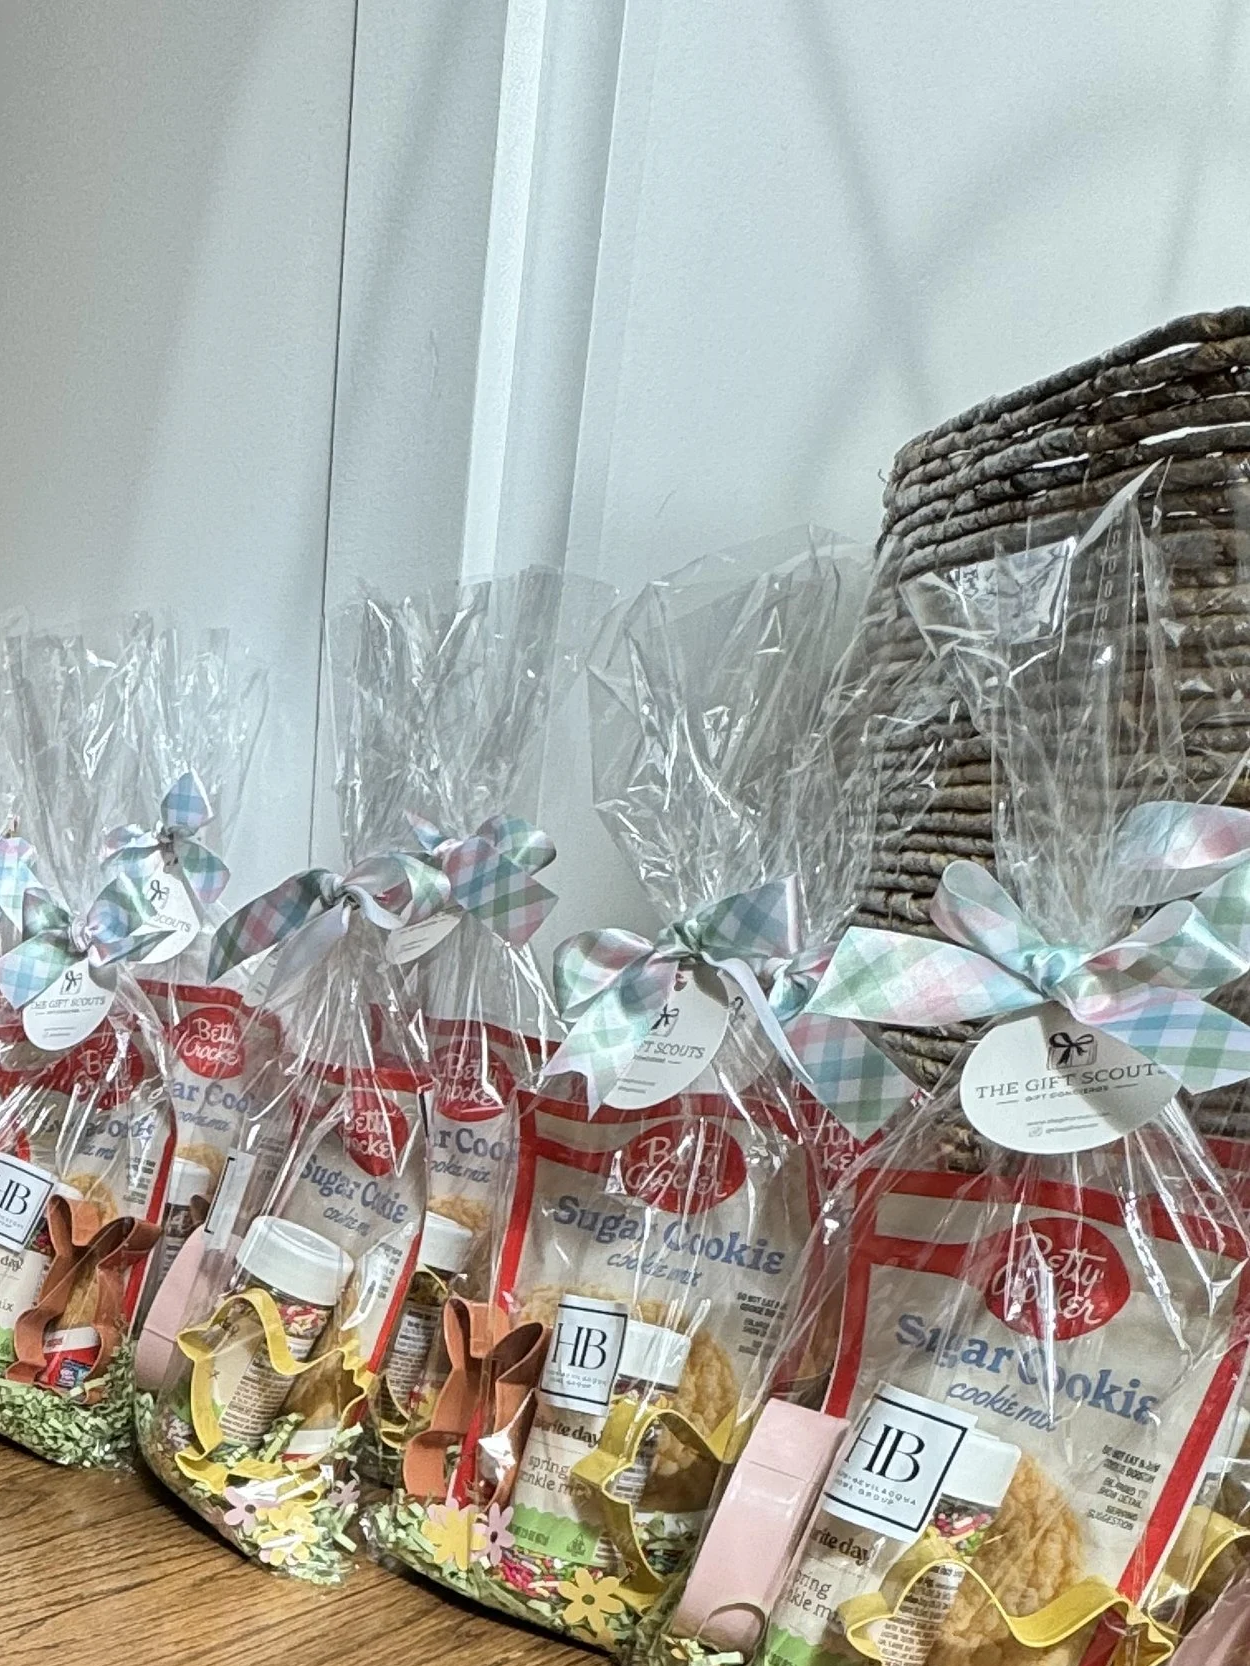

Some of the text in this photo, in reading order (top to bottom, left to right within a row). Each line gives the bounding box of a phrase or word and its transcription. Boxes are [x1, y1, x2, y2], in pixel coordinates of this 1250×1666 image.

[48, 998, 68, 1009] GIFT
[70, 996, 106, 1008] SCOUTS
[653, 1041, 706, 1060] SCOUTS
[974, 1081, 1019, 1099] THE
[1024, 1073, 1076, 1092] GIFT
[662, 1219, 786, 1275] Cookie
[550, 1322, 608, 1370] HB
[948, 1381, 1017, 1415] cookie
[1017, 1348, 1160, 1426] Cookie
[843, 1416, 926, 1483] HB
[528, 1454, 571, 1481] spring
[838, 1536, 871, 1567] day
